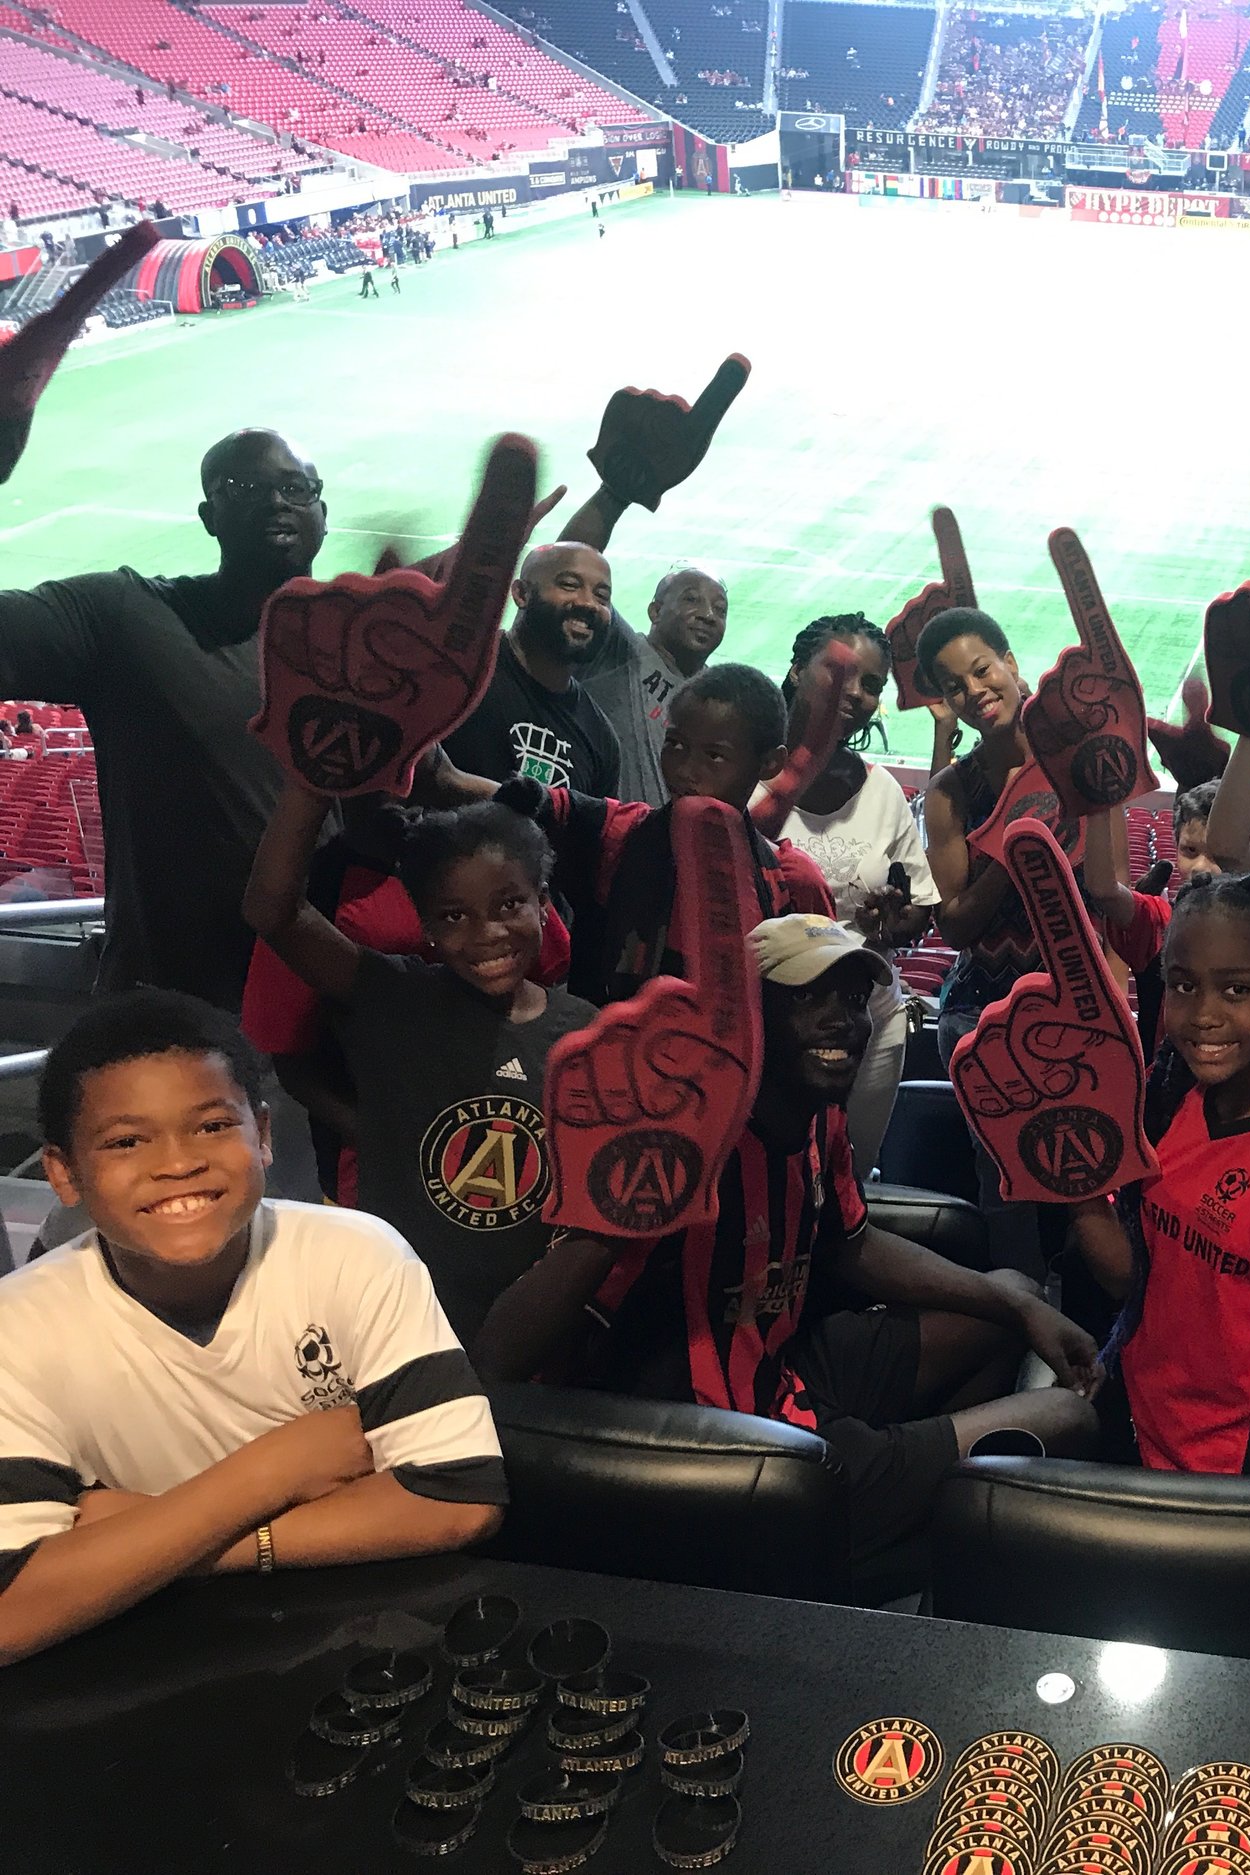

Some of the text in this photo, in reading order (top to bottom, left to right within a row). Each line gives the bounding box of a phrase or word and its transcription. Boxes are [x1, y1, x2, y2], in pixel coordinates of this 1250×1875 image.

[856, 131, 955, 149] RESURGENCE
[986, 140, 1025, 152] ROWDY
[427, 188, 517, 209] ATLANTA UNITED
[1019, 848, 1101, 1022] ATLANTA UNITED
[495, 1069, 528, 1081] adidas
[456, 1101, 548, 1141] ATLANTA
[428, 1178, 535, 1226] UNITED FC
[1200, 1193, 1237, 1223] SOCCER
[1183, 1225, 1250, 1276] UNITED
[472, 1697, 521, 1711] UNITED
[579, 1699, 627, 1714] UNITED
[861, 1720, 930, 1743] ATLANTA
[664, 1746, 725, 1765] ATLANTA
[981, 1735, 1049, 1761] ATLANTA
[560, 1757, 623, 1773] ATLANTA
[968, 1756, 1039, 1784] ATLANTA
[1093, 1748, 1161, 1777] ATLANTA
[845, 1774, 925, 1799] UNITED FC
[964, 1778, 1035, 1808] ATLANTA
[1078, 1770, 1150, 1793] ATLANTA
[959, 1808, 1028, 1840] ATLANTA
[1071, 1799, 1143, 1827] ATLANTA
[946, 1835, 1021, 1862] ATLANTA
[1065, 1821, 1139, 1850] ATLANTA
[1057, 1850, 1130, 1875] ATLANTA
